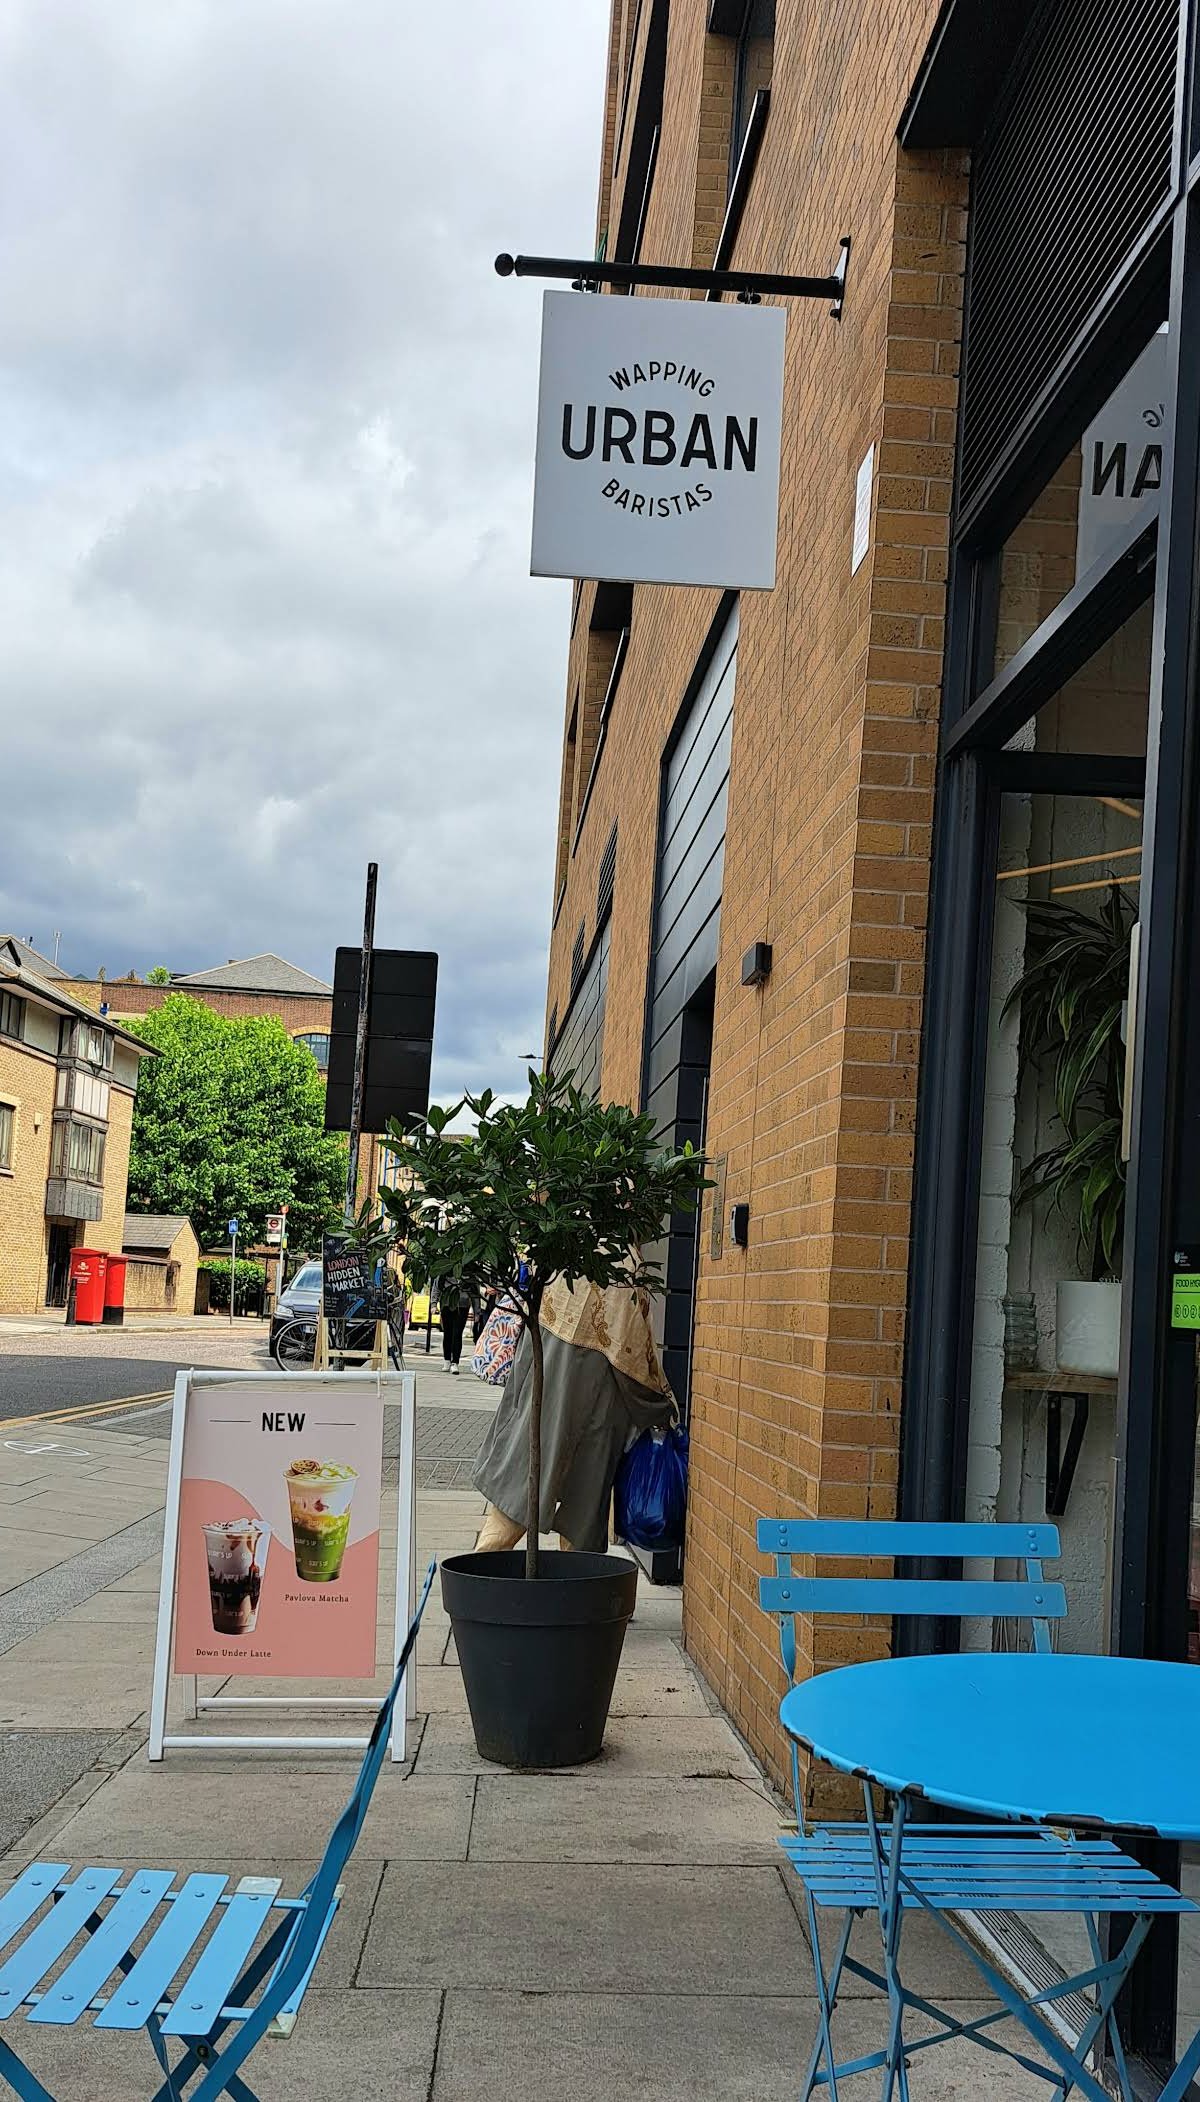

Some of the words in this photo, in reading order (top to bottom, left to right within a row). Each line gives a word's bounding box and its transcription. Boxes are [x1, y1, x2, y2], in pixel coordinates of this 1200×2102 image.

[608, 361, 716, 398] WAPPING
[561, 403, 759, 472] URBAN
[601, 478, 713, 518] BARISTAS
[327, 1266, 360, 1282] HIDDEN
[331, 1276, 365, 1293] MARKET
[261, 1412, 305, 1433] NEW
[285, 1593, 316, 1602] Pavlova
[319, 1594, 349, 1603] Matcha
[196, 1648, 219, 1657] Down
[221, 1649, 248, 1657] Under
[250, 1649, 272, 1658] Latte
